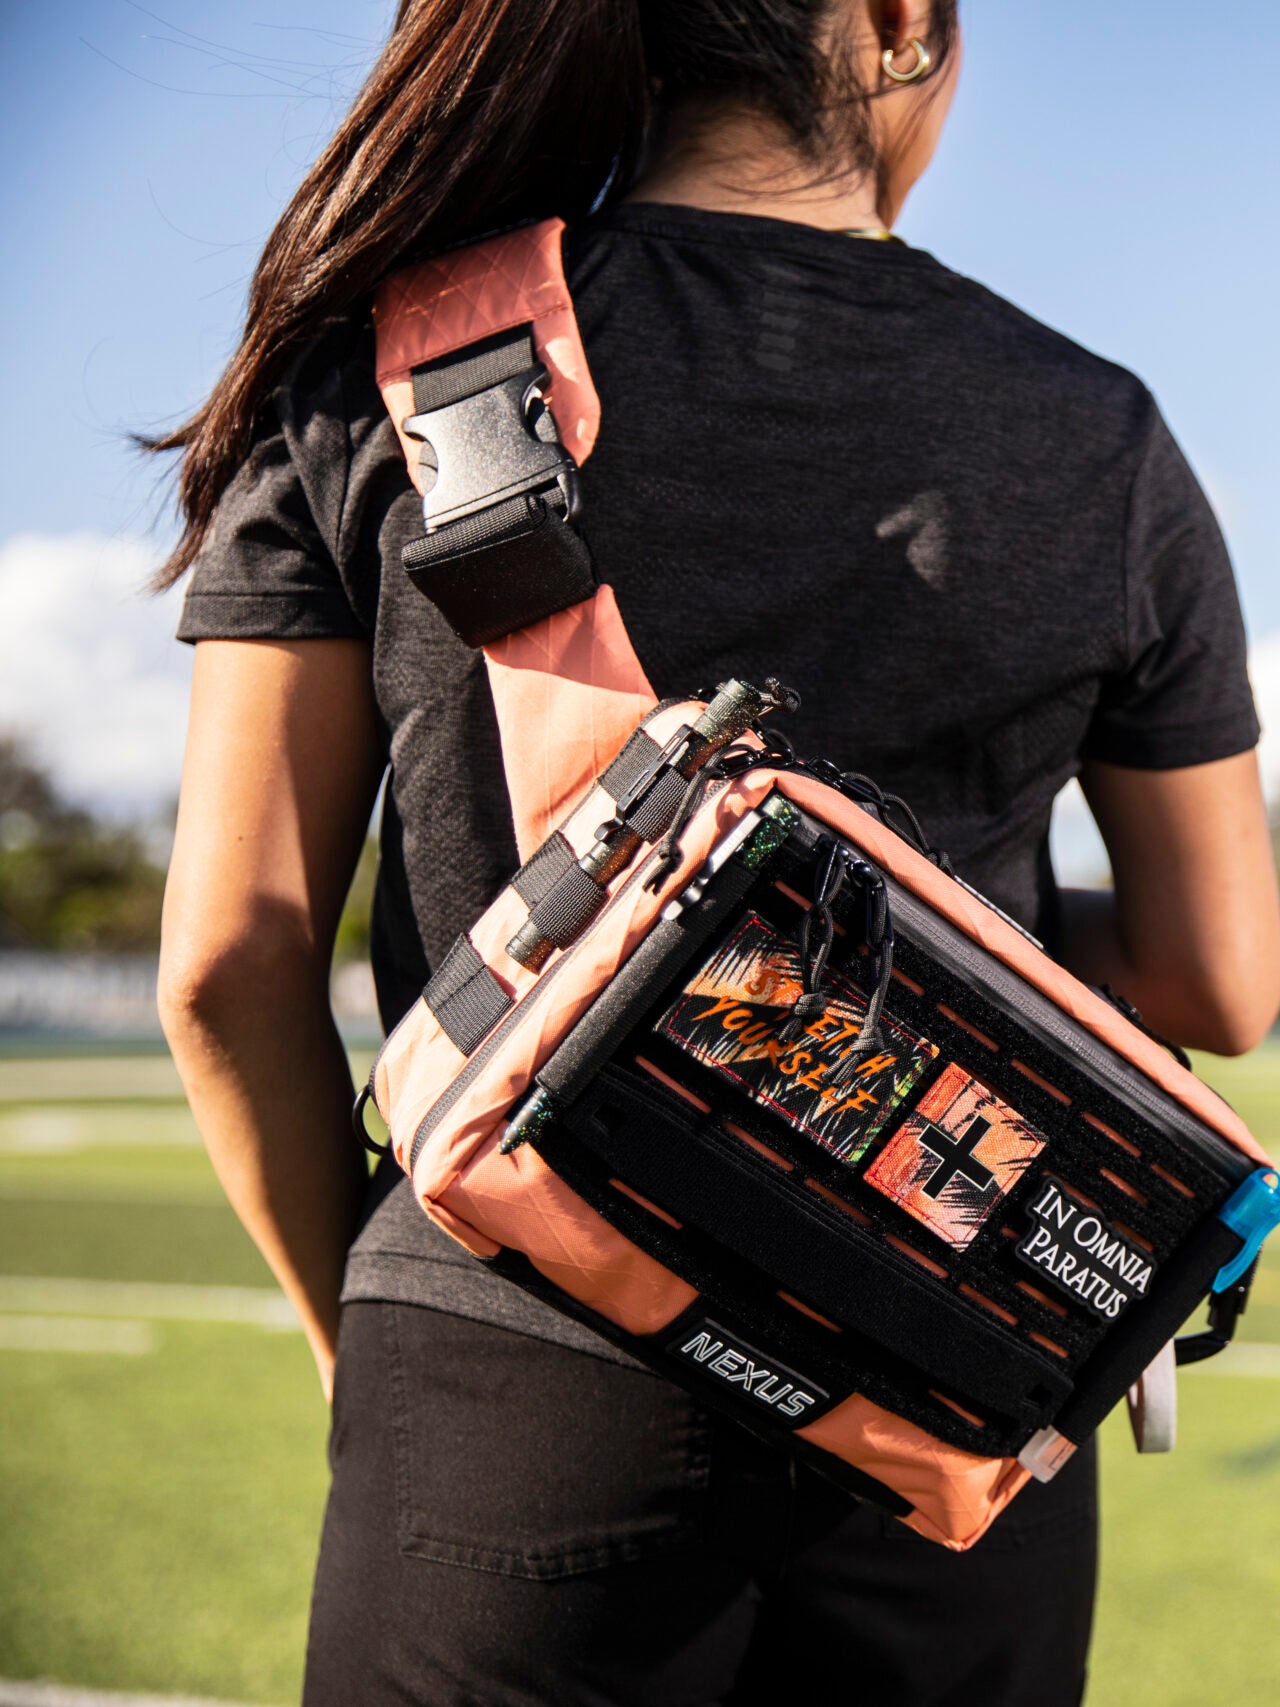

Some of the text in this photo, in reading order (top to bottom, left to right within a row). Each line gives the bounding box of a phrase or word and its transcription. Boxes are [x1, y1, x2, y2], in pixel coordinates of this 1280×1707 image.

[745, 972, 898, 1077] STETH
[1022, 1225, 1128, 1318] PARATUS
[1033, 1185, 1153, 1294] IN OMNIA
[681, 1331, 816, 1417] NEXUS
